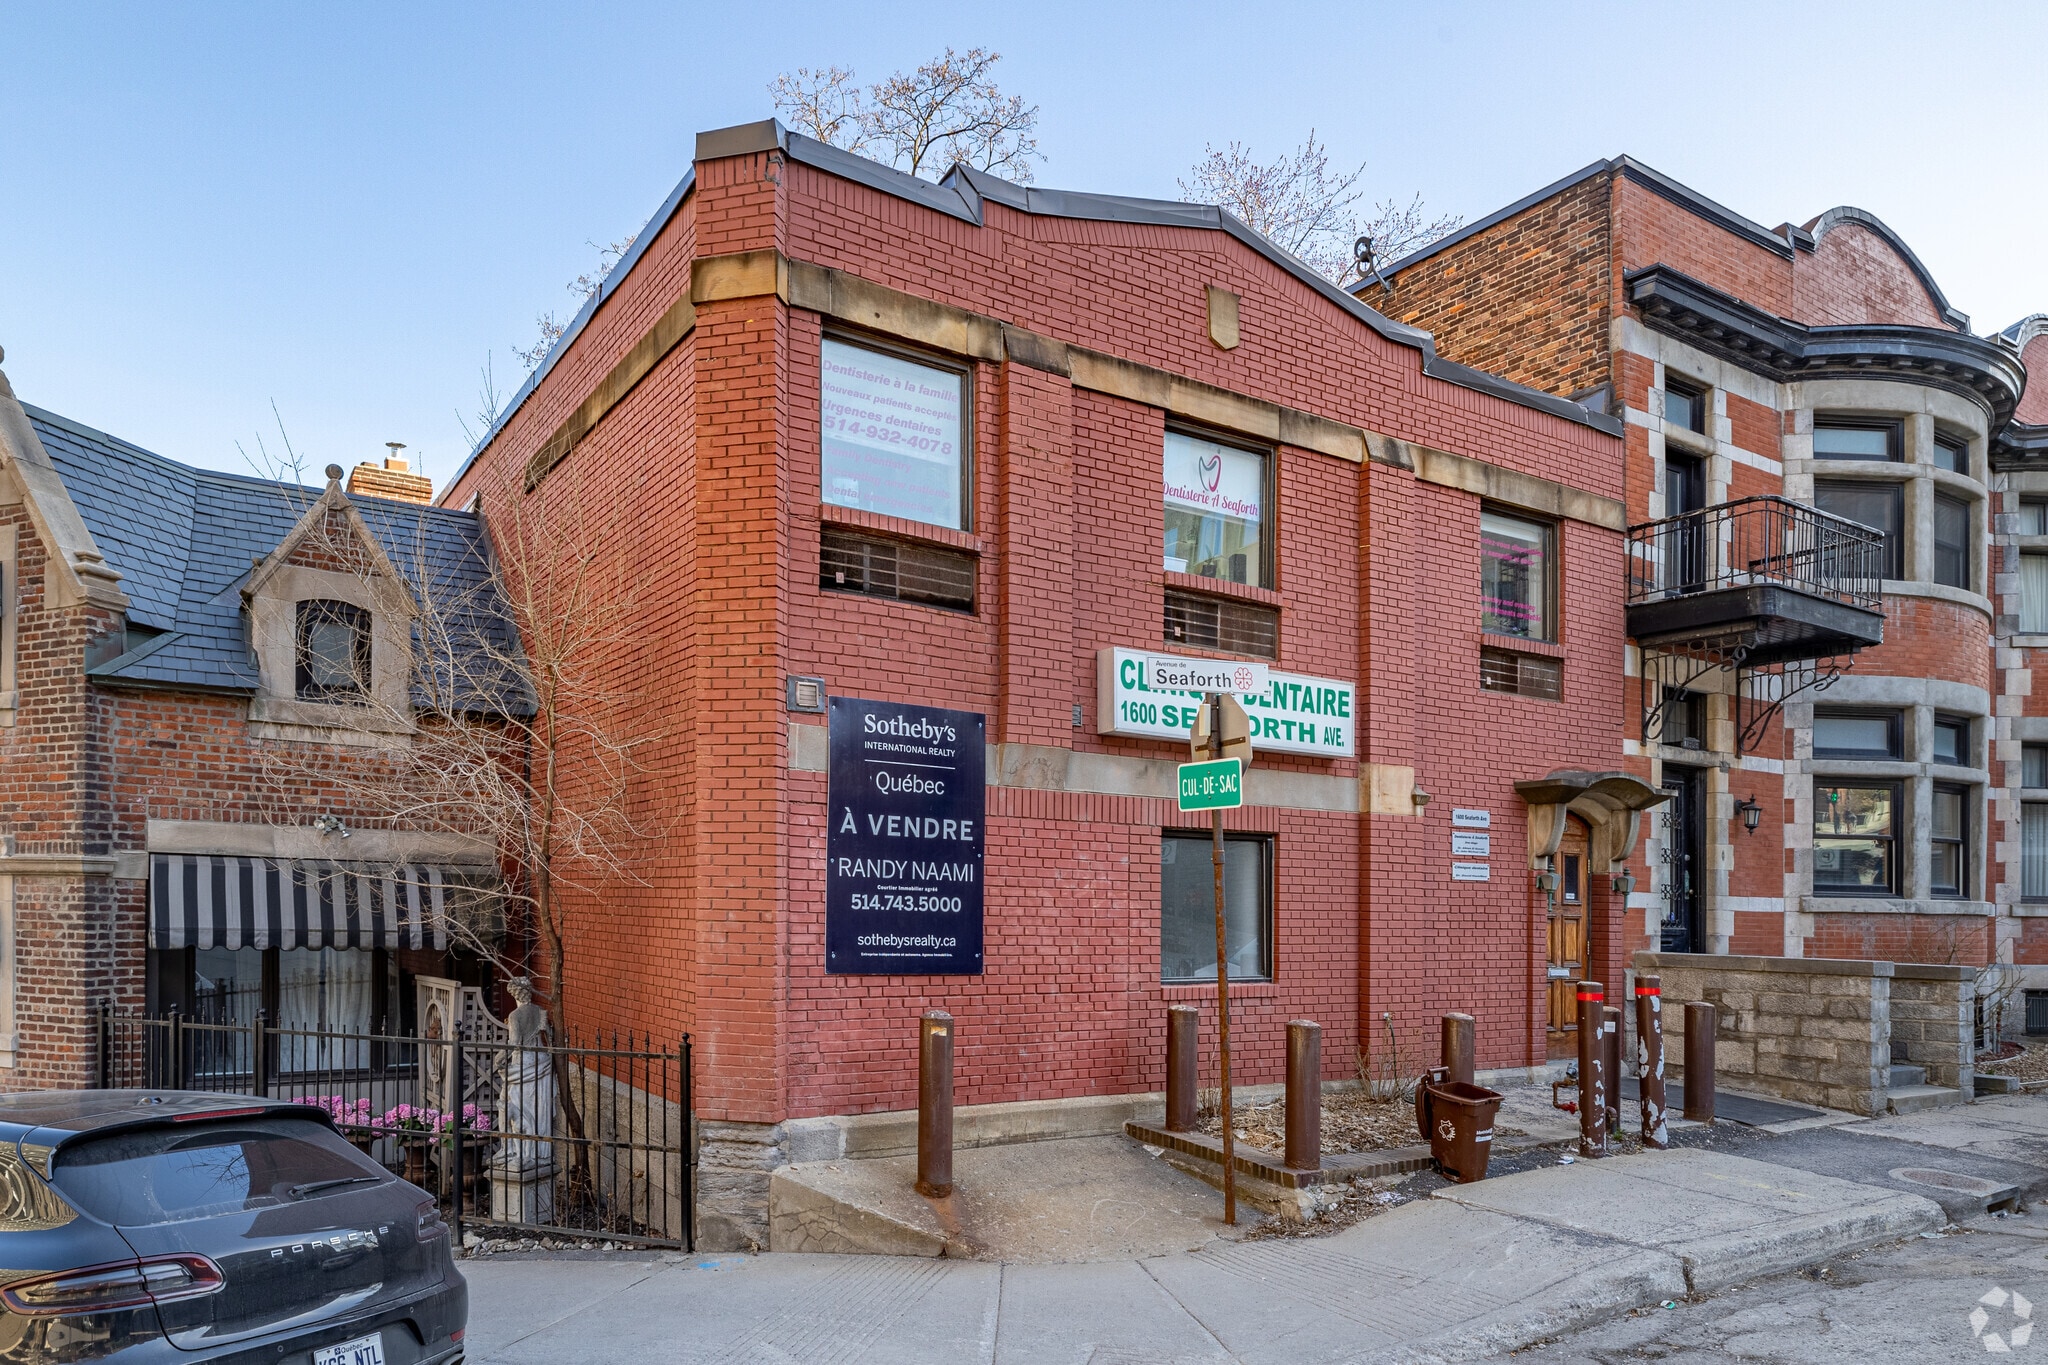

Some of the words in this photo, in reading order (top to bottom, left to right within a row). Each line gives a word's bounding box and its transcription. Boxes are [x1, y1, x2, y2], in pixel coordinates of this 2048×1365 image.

[823, 359, 891, 386] Dentisterie
[893, 377, 901, 389] à
[904, 380, 916, 392] la
[918, 384, 958, 403] famille
[823, 381, 871, 401] Nouveaux
[873, 393, 913, 411] patients
[823, 399, 882, 422] Urgences
[885, 415, 942, 436] dentaires
[823, 416, 952, 455] 514-932-4078
[825, 443, 861, 461] Family
[864, 452, 912, 473] Dentistry
[826, 482, 860, 499] Dental
[1163, 482, 1209, 504] Dentisterie
[1221, 496, 1258, 517] Seaforth
[1156, 660, 1177, 668] Avenue
[1156, 669, 1231, 687] Seaforth
[864, 713, 956, 744] Sotheby's
[1121, 700, 1157, 725] 1600
[1162, 705, 1315, 744] SEORTH
[1323, 726, 1345, 747] AVE.
[864, 741, 927, 755] INTERNATIONAL
[928, 747, 956, 758] REALTY
[875, 771, 945, 795] Québec
[1182, 773, 1237, 797] CUL-DE-SAC
[840, 806, 857, 834] À
[868, 814, 974, 841] VENDRE
[838, 857, 908, 879] RANDY
[912, 861, 974, 882] NAAMI
[851, 893, 962, 913] 514.743.5000
[857, 934, 957, 952] sothebysrealty.ca
[270, 1226, 389, 1258] PORSCHE
[341, 1343, 363, 1354] Québec
